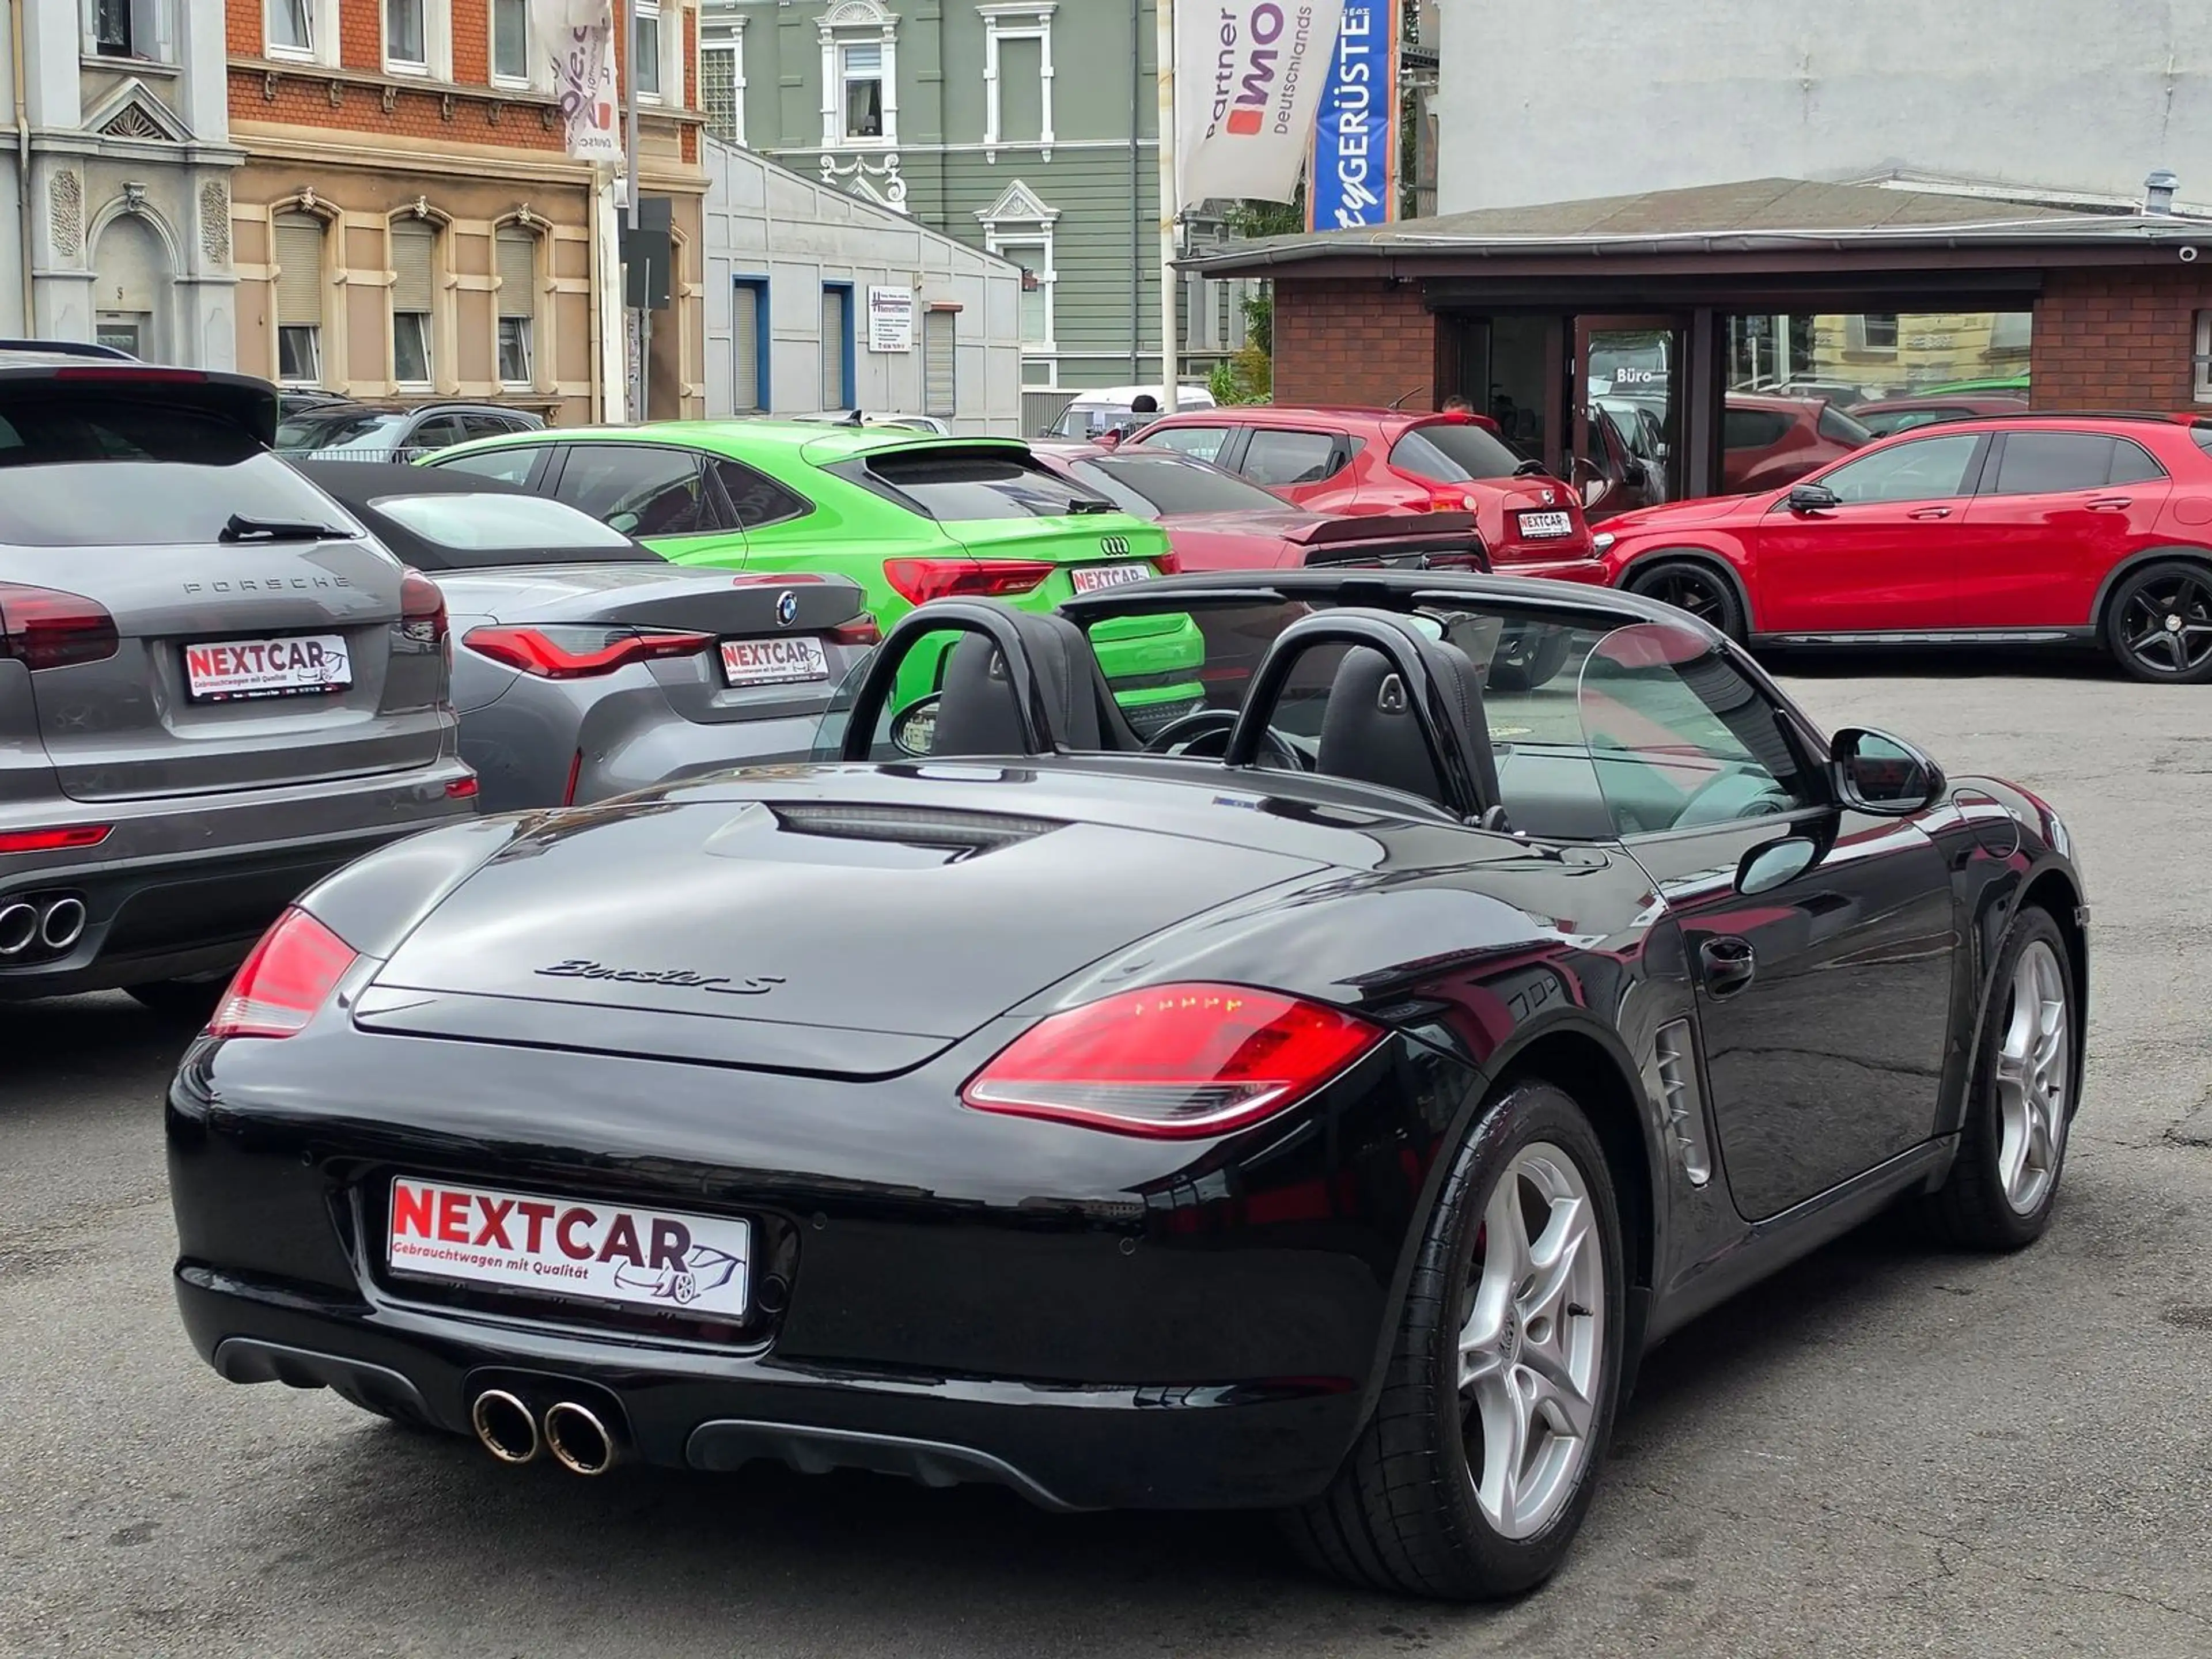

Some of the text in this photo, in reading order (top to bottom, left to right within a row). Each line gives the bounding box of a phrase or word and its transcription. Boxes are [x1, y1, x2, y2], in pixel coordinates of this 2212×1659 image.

[1273, 6, 1312, 134] Deutschlands
[1618, 368, 1652, 382] Büro
[1520, 514, 1562, 528] NEXTCAR
[183, 577, 349, 594] PORSCHE
[189, 641, 326, 677] NEXTCAR
[722, 641, 810, 667] NEXTCAR
[393, 1184, 691, 1274] NEXTCAR
[392, 1241, 589, 1279] Gebrauchtwagen mit Qualität
